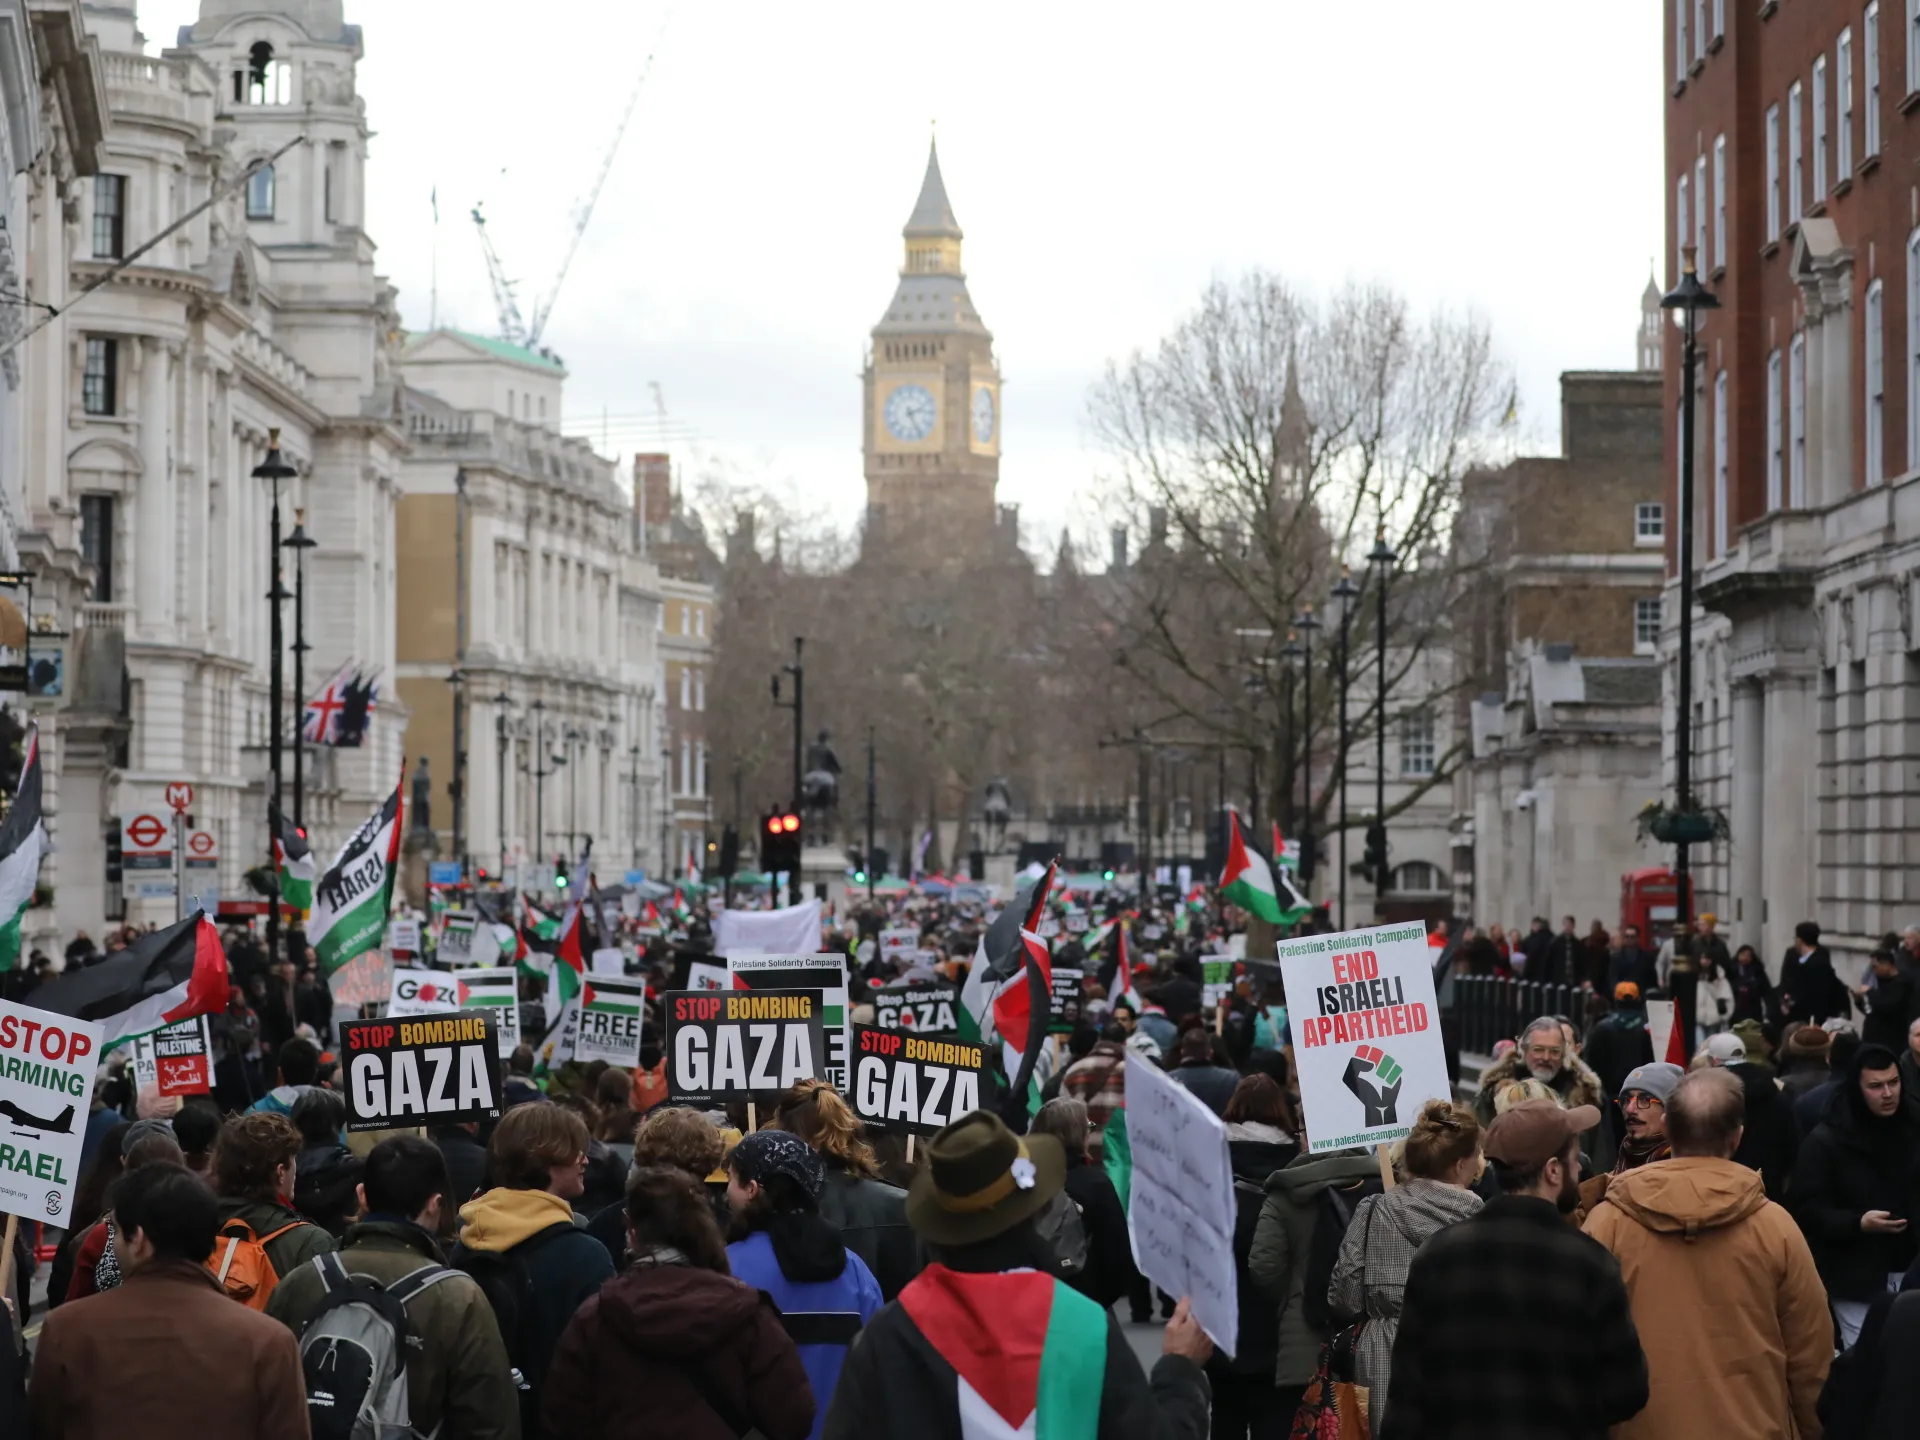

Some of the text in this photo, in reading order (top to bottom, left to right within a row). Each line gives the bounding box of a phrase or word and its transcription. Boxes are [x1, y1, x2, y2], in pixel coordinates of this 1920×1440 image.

[170, 785, 188, 804] M
[1280, 927, 1424, 957] Palestine Solidarity Campaign
[768, 960, 804, 968] Solidarity
[805, 959, 841, 968] Campaign
[1332, 950, 1379, 984] END
[675, 996, 812, 1020] STOP BOMBING
[876, 989, 954, 1007] Stop Starving
[1317, 975, 1404, 1016] ISRAELI
[581, 1011, 638, 1037] FREE
[878, 1002, 957, 1032] GAZA
[1303, 1002, 1429, 1048] APARTHEID
[0, 1015, 92, 1065] STOP
[156, 1038, 203, 1056] PALESTINE
[349, 1018, 486, 1049] STOP BOMBING
[579, 1033, 636, 1048] PALESTINE
[675, 1023, 814, 1091] GAZA
[861, 1030, 901, 1056] STOP
[905, 1037, 982, 1069] BOMBING
[162, 1073, 201, 1090] لفلسطين
[164, 1059, 195, 1075] الحرية
[351, 1044, 494, 1119] GAZA
[856, 1056, 980, 1127] GAZA
